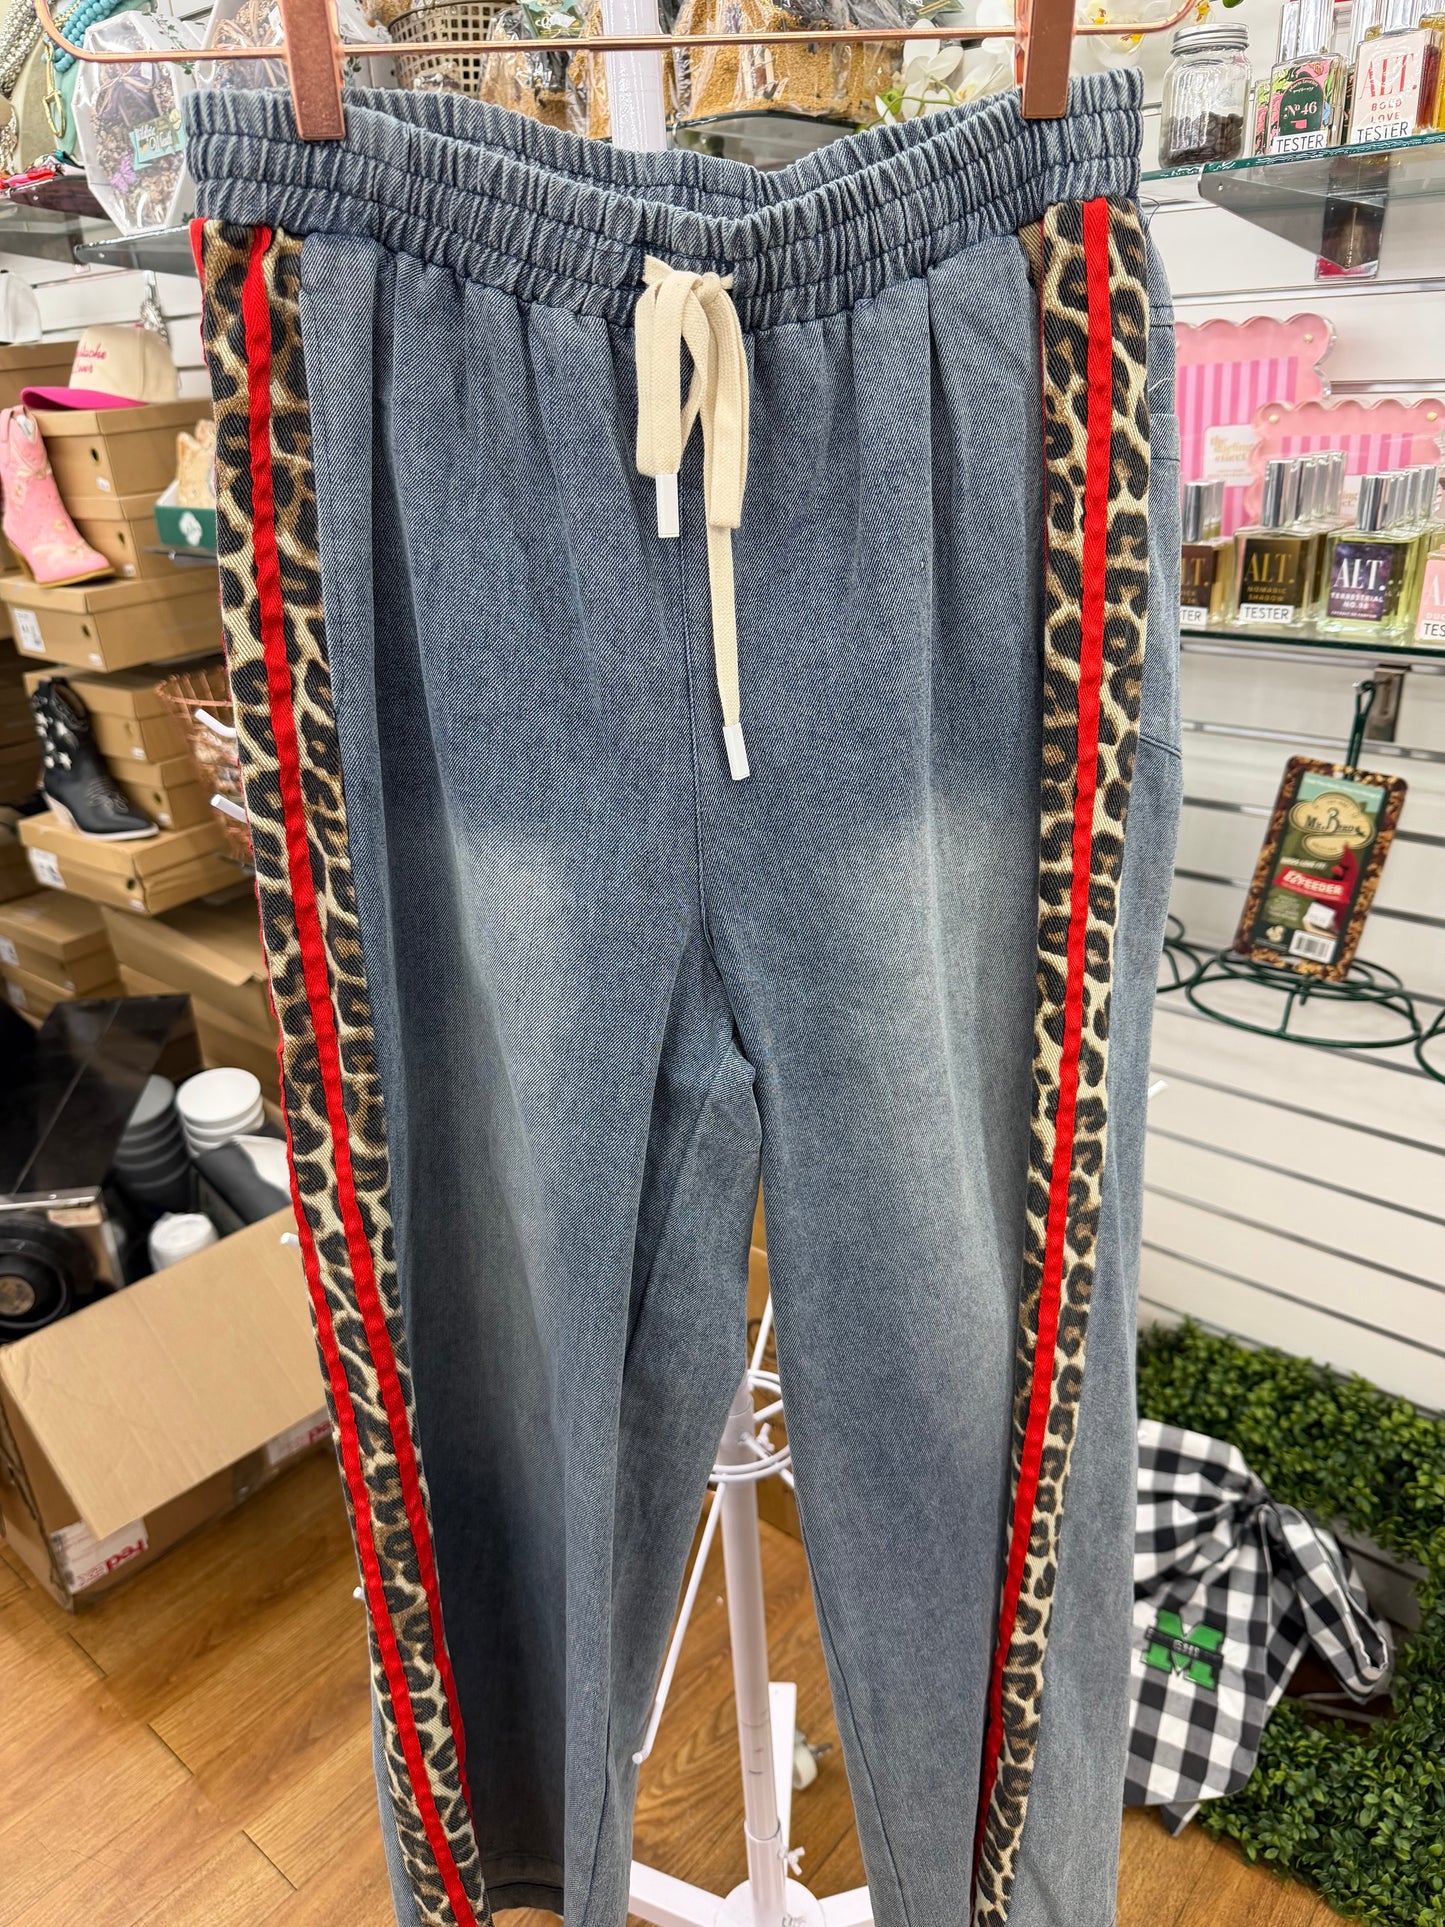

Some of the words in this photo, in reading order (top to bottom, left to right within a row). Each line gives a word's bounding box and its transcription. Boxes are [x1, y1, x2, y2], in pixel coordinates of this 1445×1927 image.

[1301, 101, 1317, 115] 46
[1357, 121, 1409, 143] TESTER
[1277, 134, 1324, 153] TESTER
[1180, 558, 1209, 587] LT.
[1244, 552, 1296, 584] ALT.
[1180, 608, 1202, 621] TER
[1245, 606, 1290, 621] TESTER
[1424, 622, 1445, 638] TES
